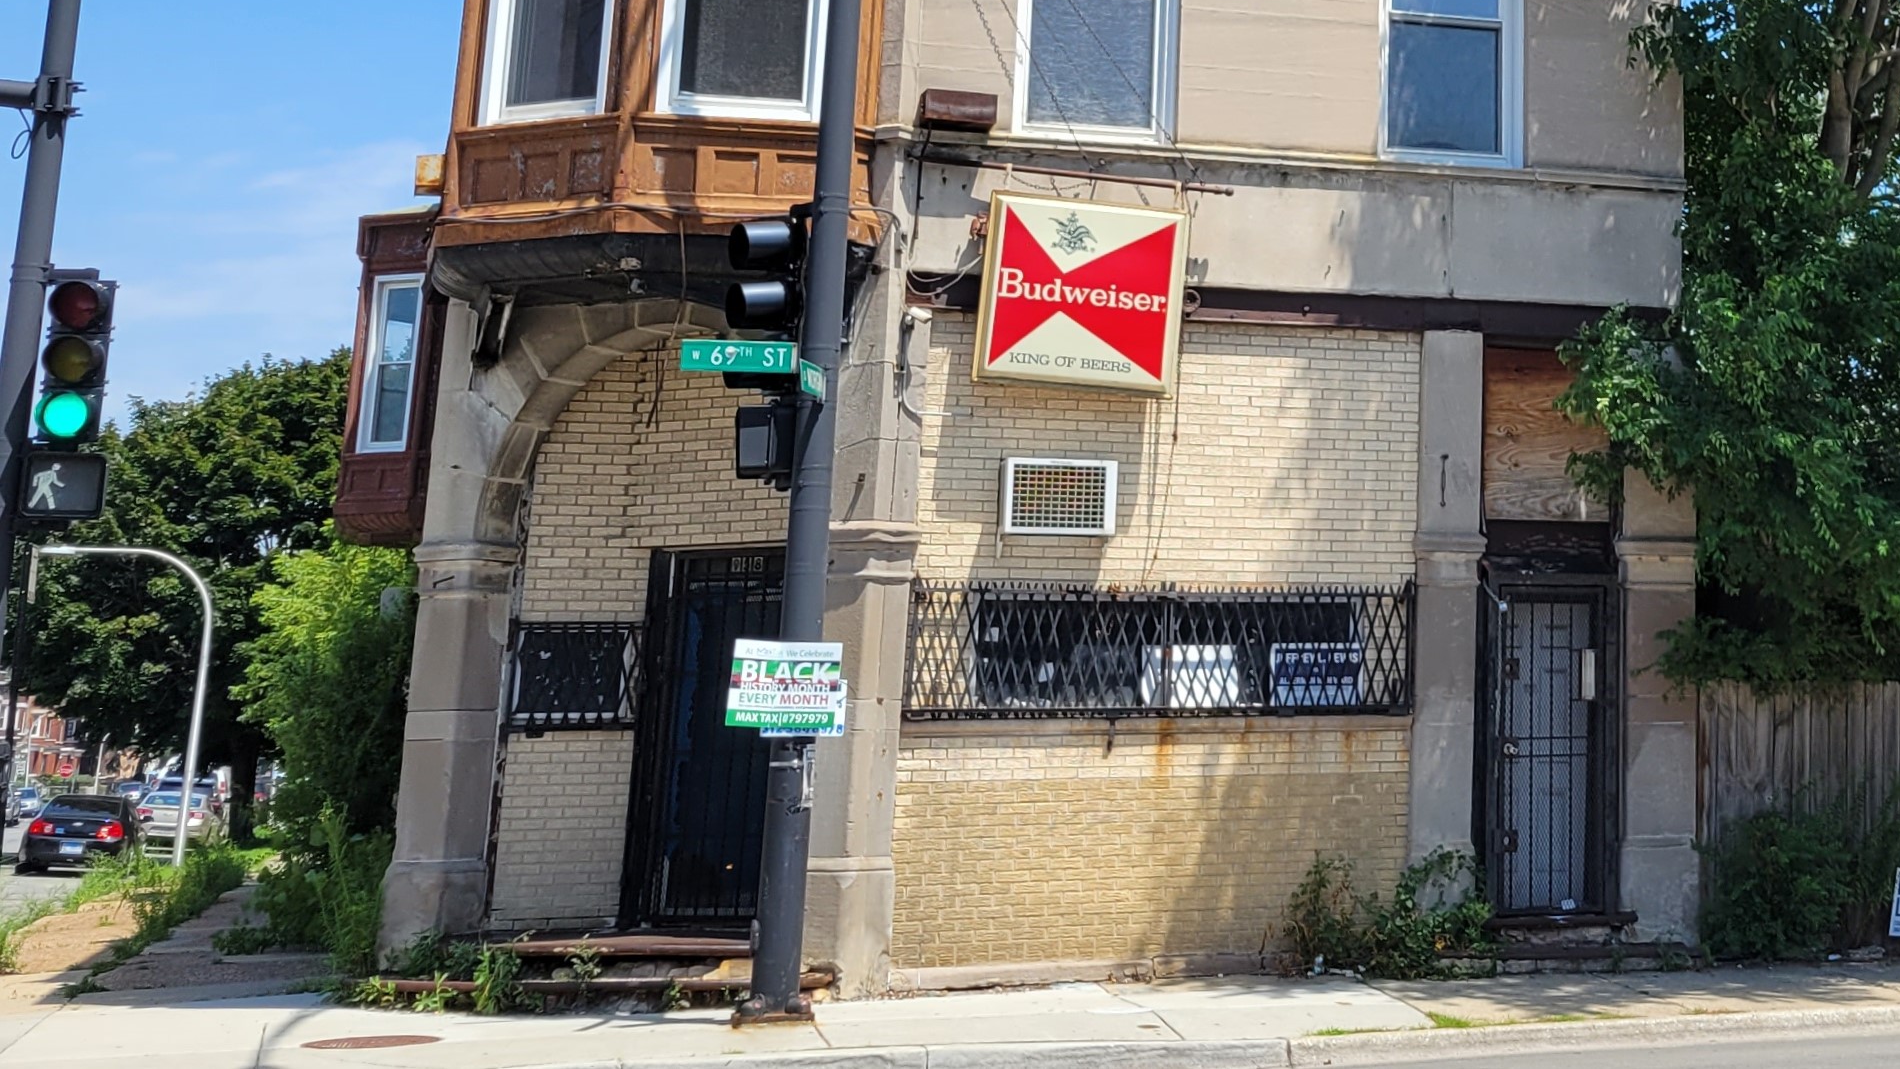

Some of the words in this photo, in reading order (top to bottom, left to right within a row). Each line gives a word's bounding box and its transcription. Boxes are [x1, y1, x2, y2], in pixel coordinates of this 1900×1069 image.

[998, 267, 1167, 312] Budweiser
[692, 349, 700, 360] W
[711, 345, 752, 366] 69TH
[762, 347, 787, 367] ST
[1009, 351, 1050, 367] KING
[1054, 355, 1077, 368] OF
[1080, 358, 1132, 373] BEERS
[740, 660, 832, 684] BLACK
[740, 682, 785, 692] HISTORY
[788, 684, 830, 692] MONTH
[738, 693, 777, 704] EVERY
[779, 694, 829, 705] MONTH
[735, 712, 758, 723] MAX
